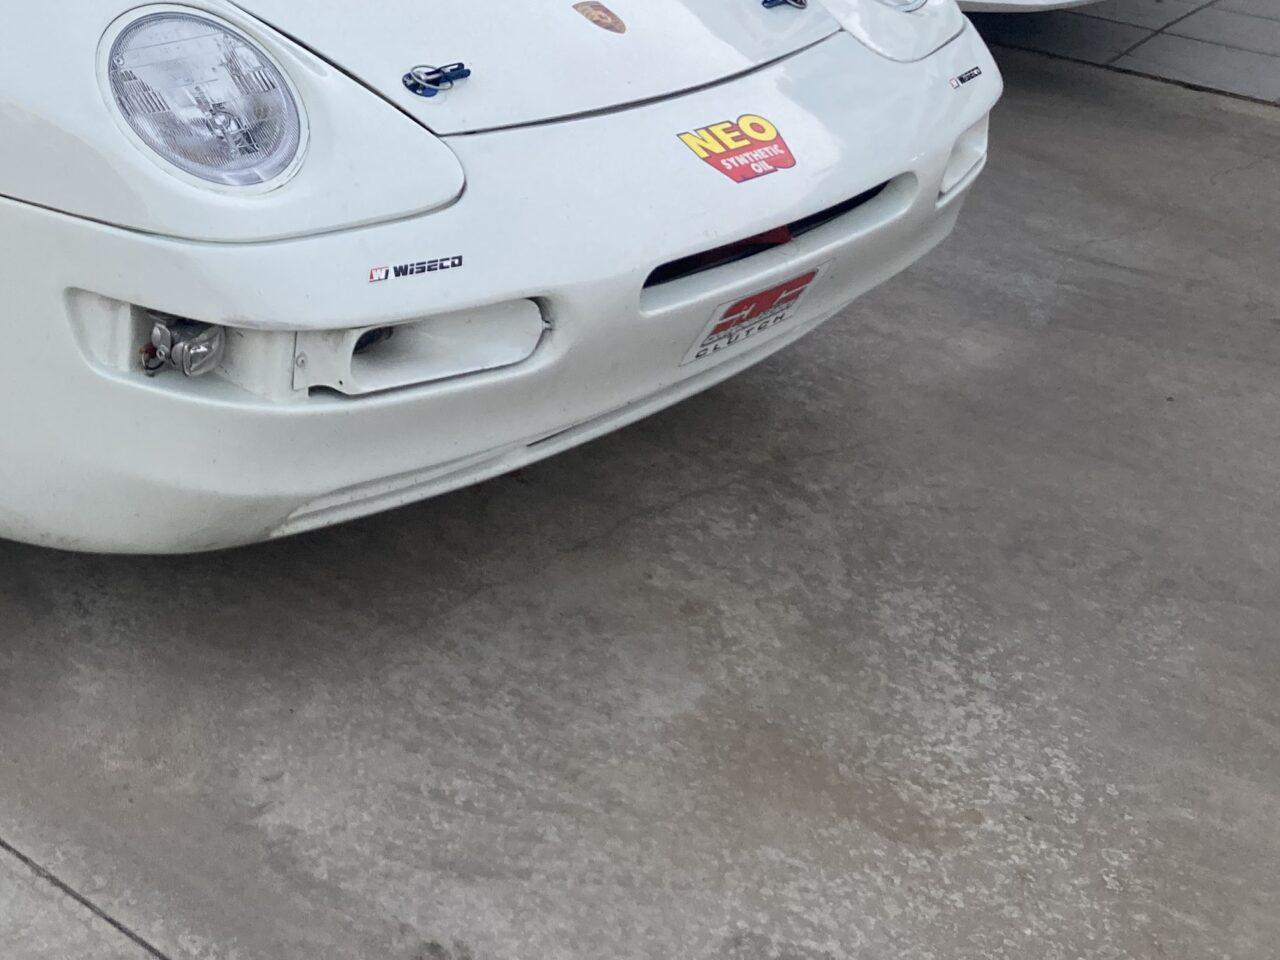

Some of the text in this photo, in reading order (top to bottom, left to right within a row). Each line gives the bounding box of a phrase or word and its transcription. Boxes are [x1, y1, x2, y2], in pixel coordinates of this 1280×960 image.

[677, 114, 779, 159] NEO
[720, 144, 786, 170] SYNTHETIC
[750, 160, 775, 174] OIL
